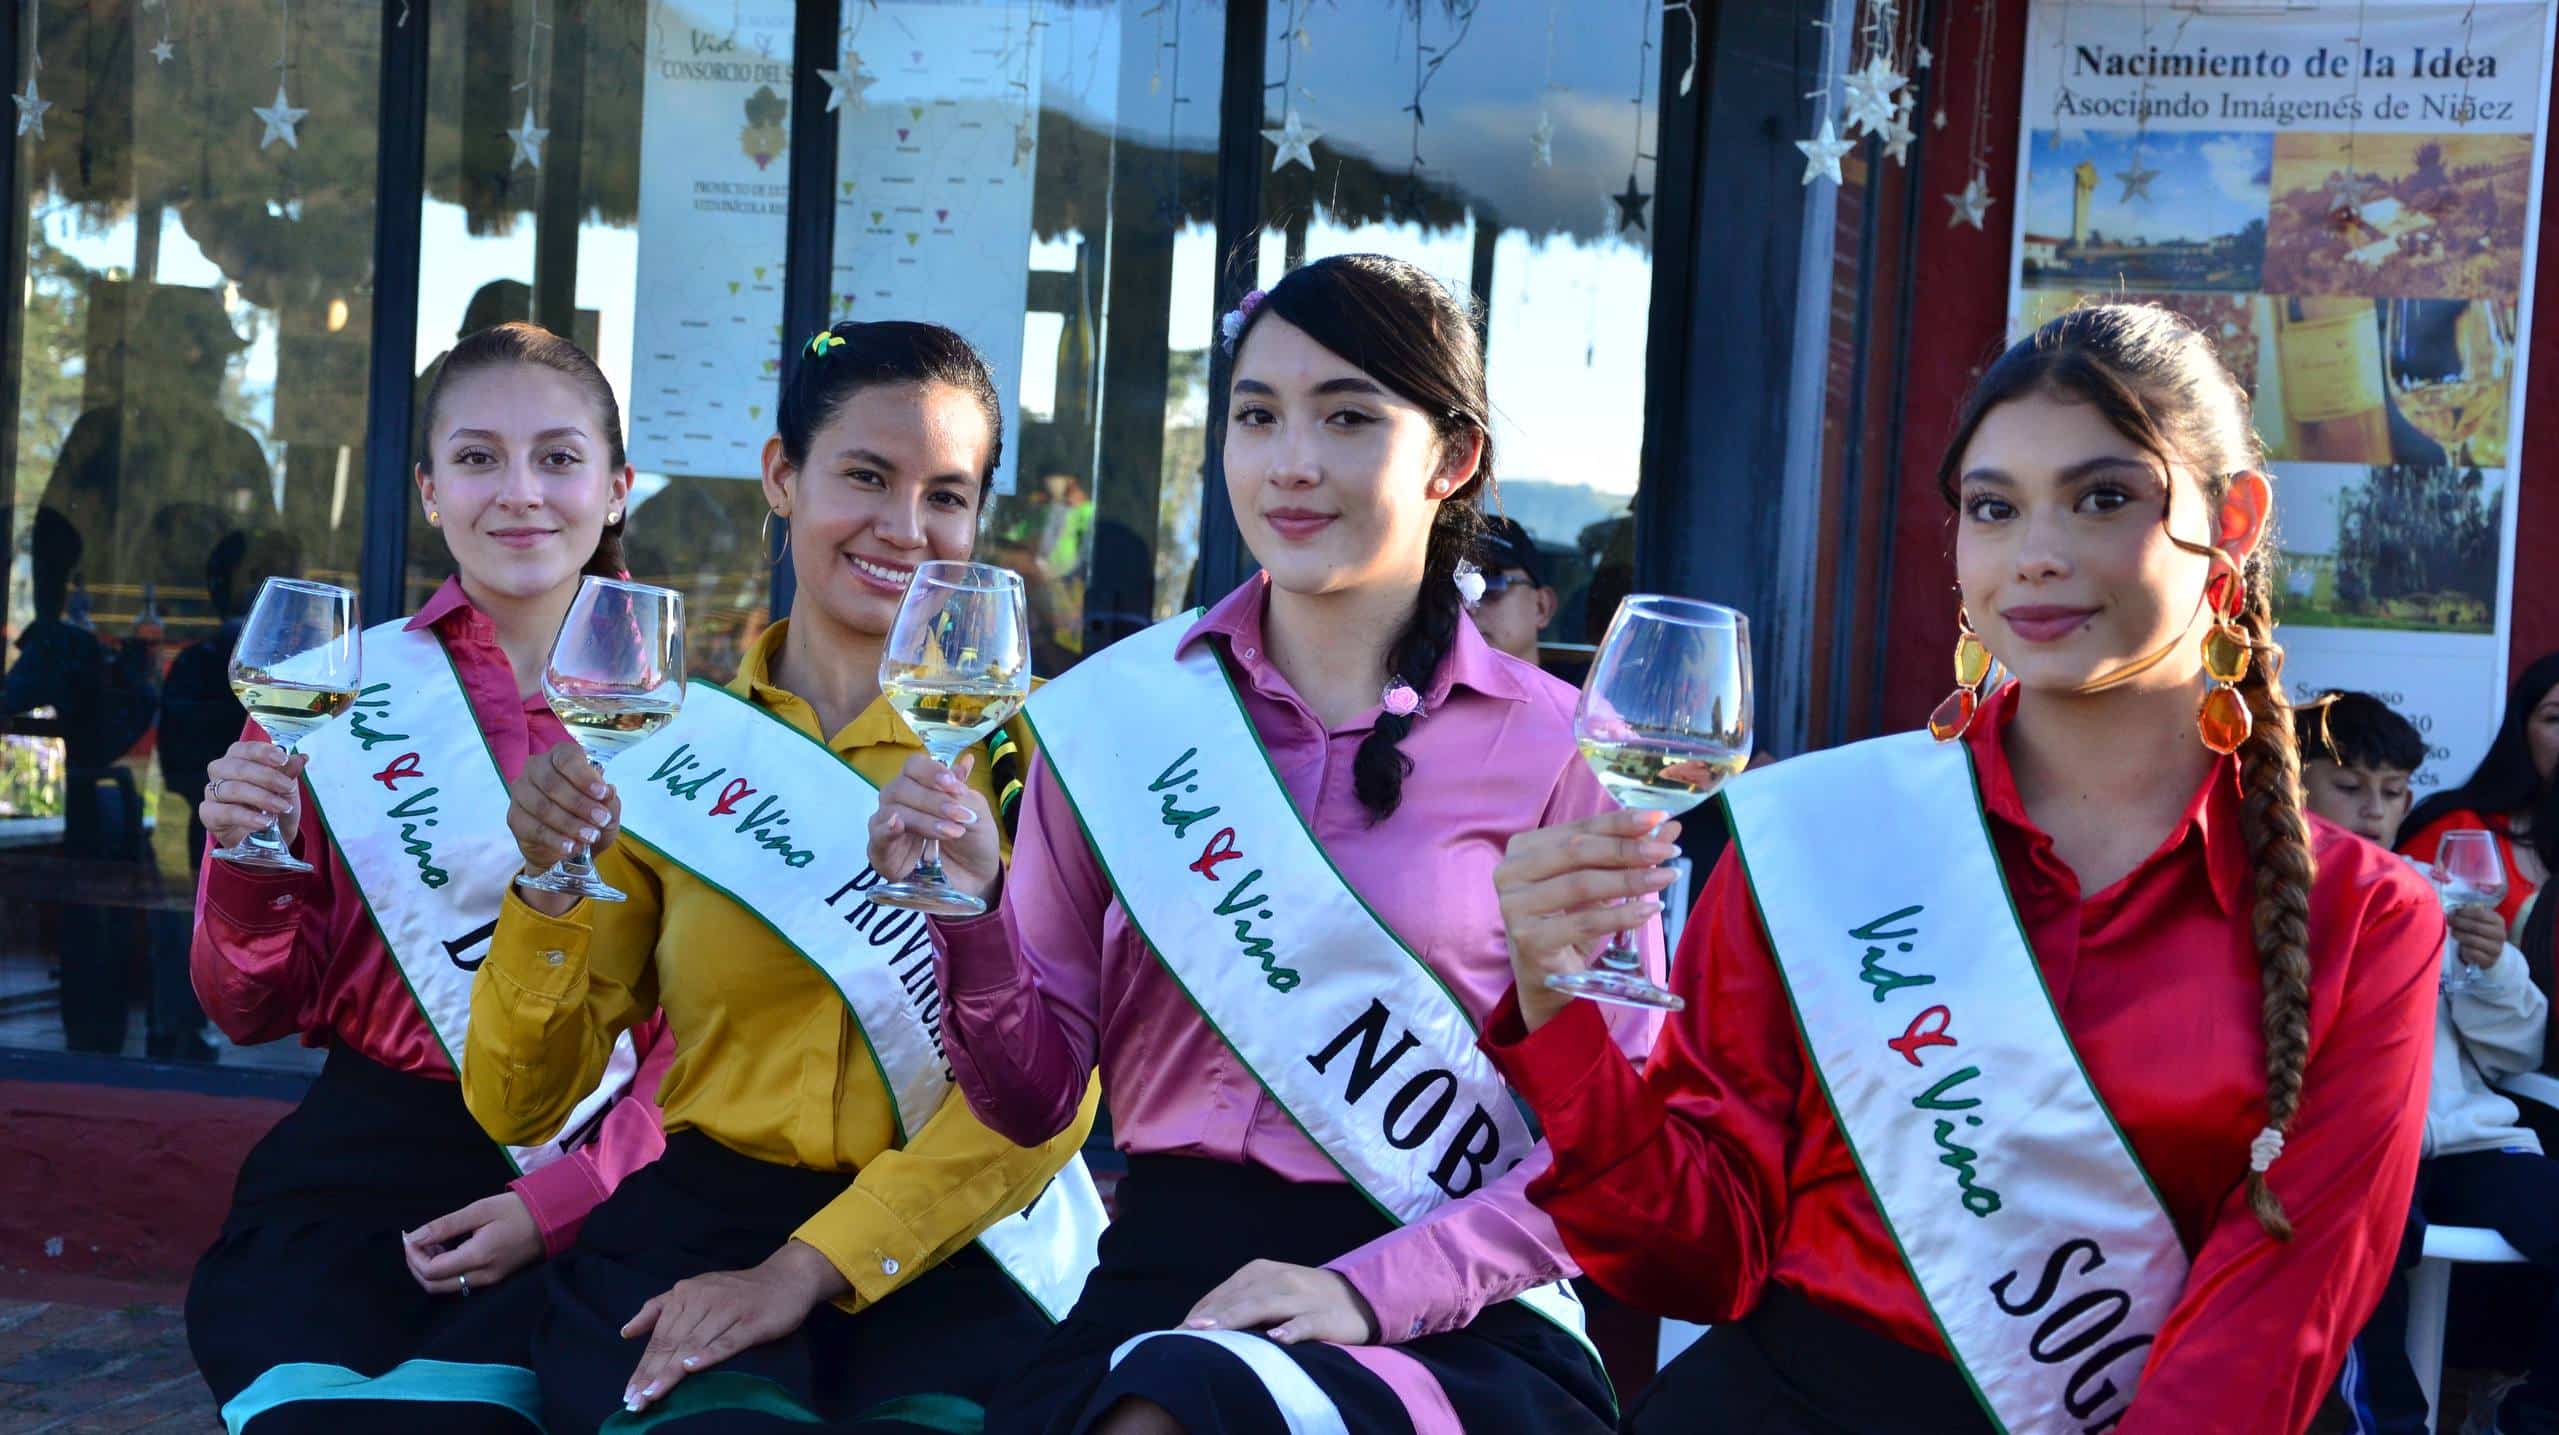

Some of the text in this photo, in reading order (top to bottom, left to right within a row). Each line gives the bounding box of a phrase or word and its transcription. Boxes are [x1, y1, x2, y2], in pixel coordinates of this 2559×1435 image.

[662, 61, 751, 82] CONSORCIO
[753, 64, 781, 83] DEL
[2054, 92, 2514, 126] Asociando Imágenes de Niñez
[2073, 45, 2498, 79] Nacimiento de la Idea
[354, 682, 409, 751] Vid
[386, 786, 449, 890] Vino
[647, 743, 727, 801] Vid
[734, 794, 816, 869] Vino
[1147, 747, 1221, 839] Vid
[1213, 868, 1301, 994] Vino
[1306, 997, 1523, 1200] NOB
[1848, 904, 1937, 1003] Vid
[1911, 1065, 2002, 1218] Vino
[1989, 1238, 2156, 1435] SOG
